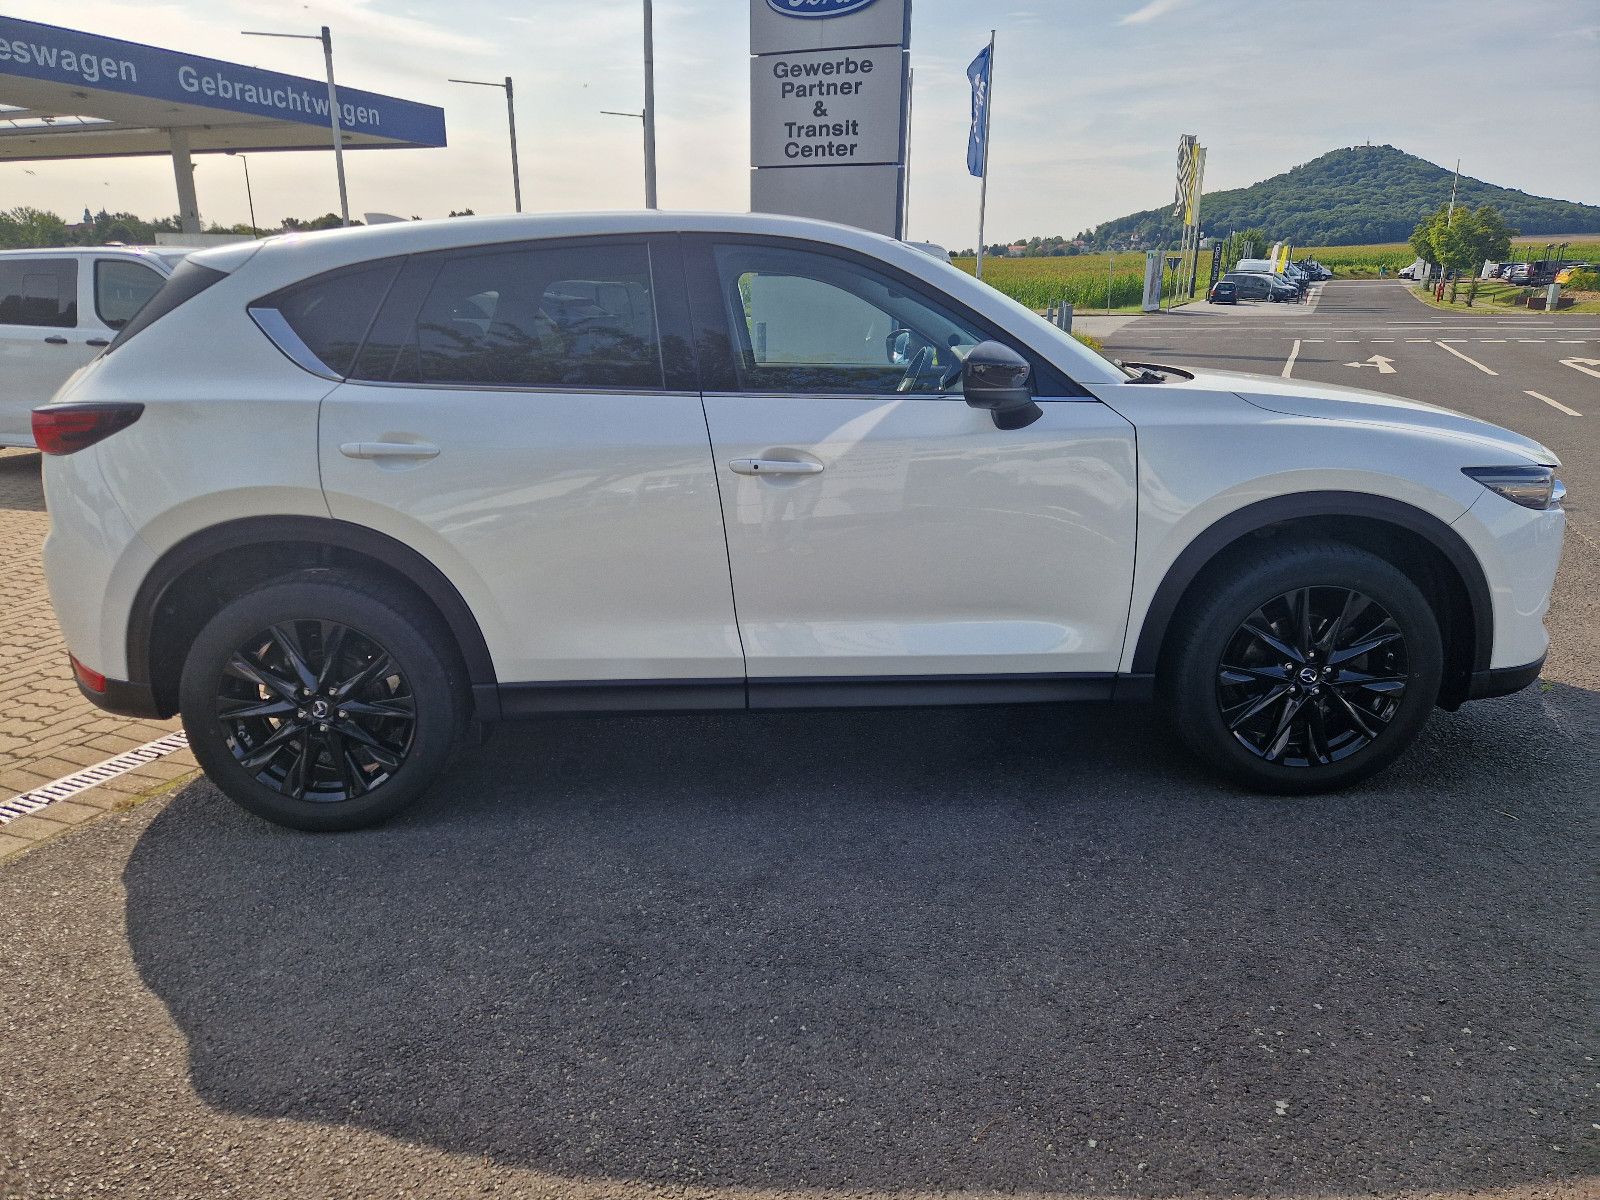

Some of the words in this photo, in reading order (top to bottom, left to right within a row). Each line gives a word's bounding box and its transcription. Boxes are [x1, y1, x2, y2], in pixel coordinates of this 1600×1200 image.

[773, 57, 874, 78] Gewerbe
[781, 80, 863, 99] Partner
[812, 101, 829, 118] &
[784, 119, 859, 138] Transit
[784, 141, 858, 159] Center
